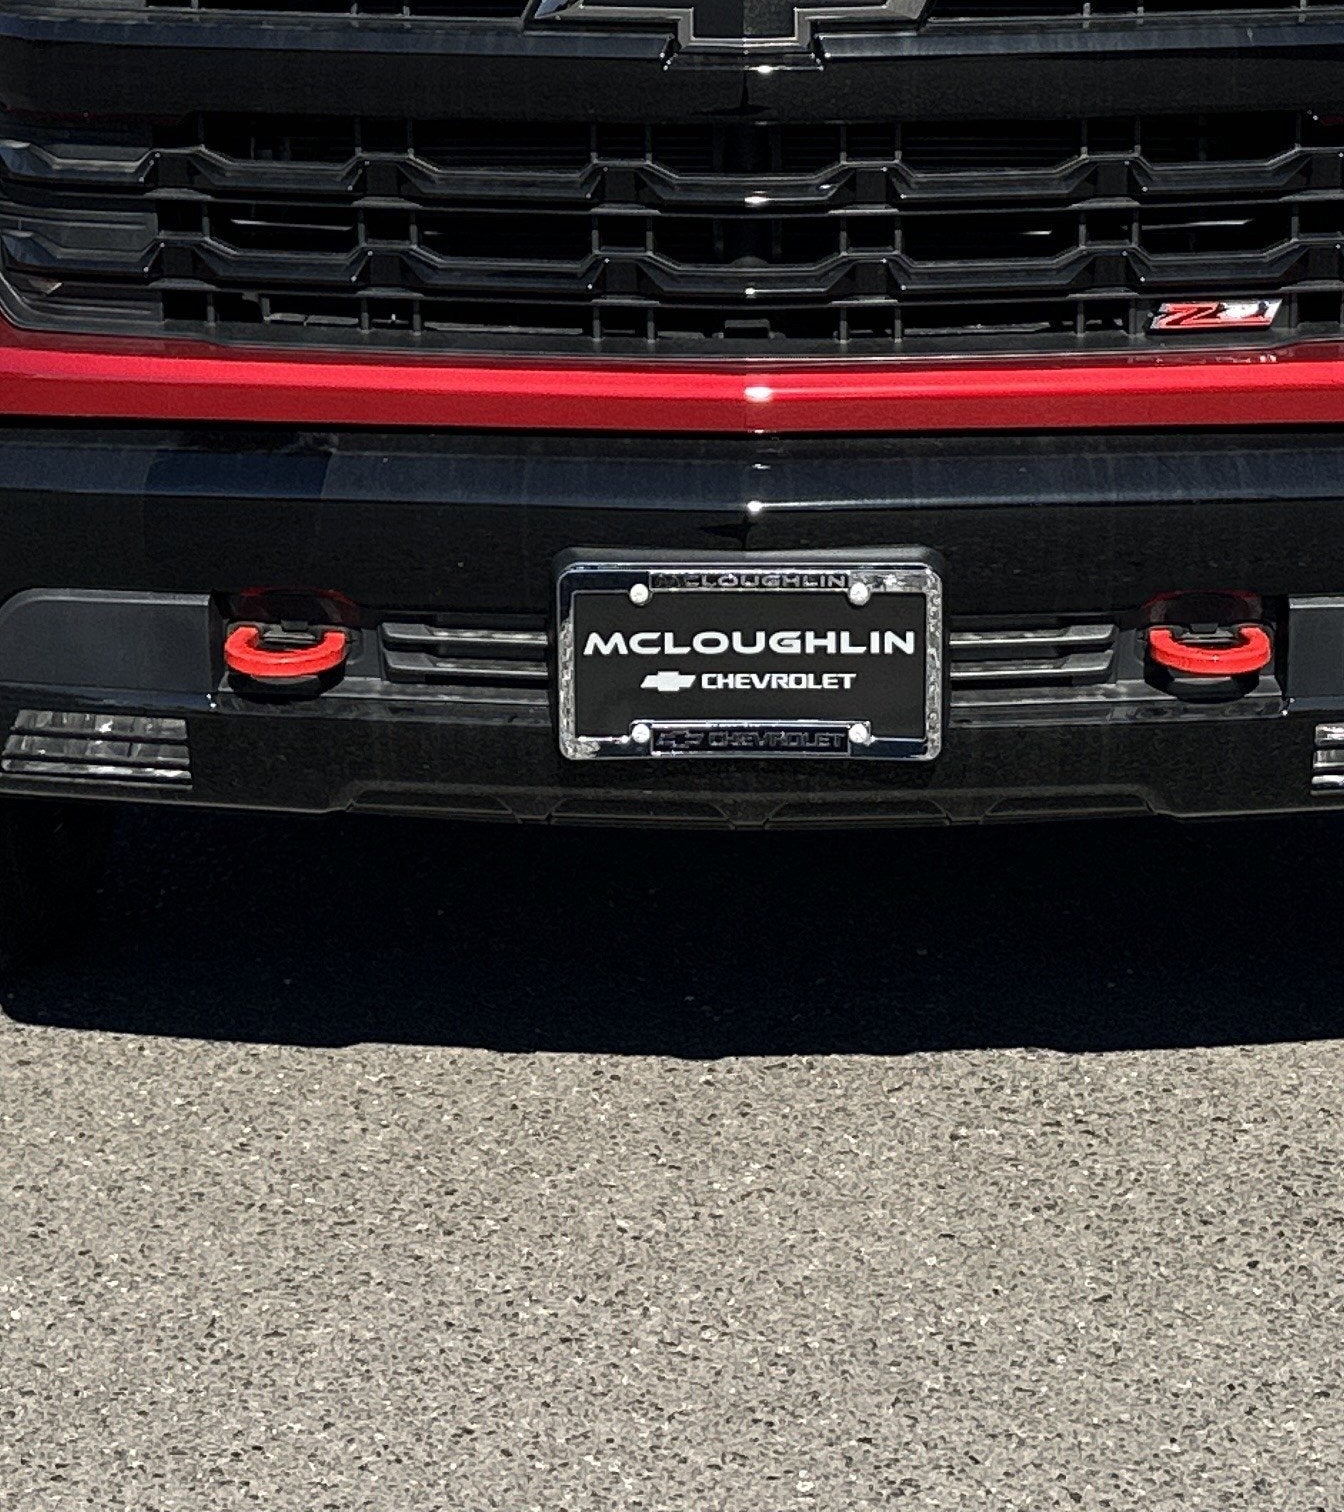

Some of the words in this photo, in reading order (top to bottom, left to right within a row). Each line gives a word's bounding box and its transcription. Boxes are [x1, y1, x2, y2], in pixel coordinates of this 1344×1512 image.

[582, 630, 916, 656] MCLOUGHLIN
[701, 672, 857, 690] CHEVROLET
[708, 731, 846, 748] CHEVROLET
